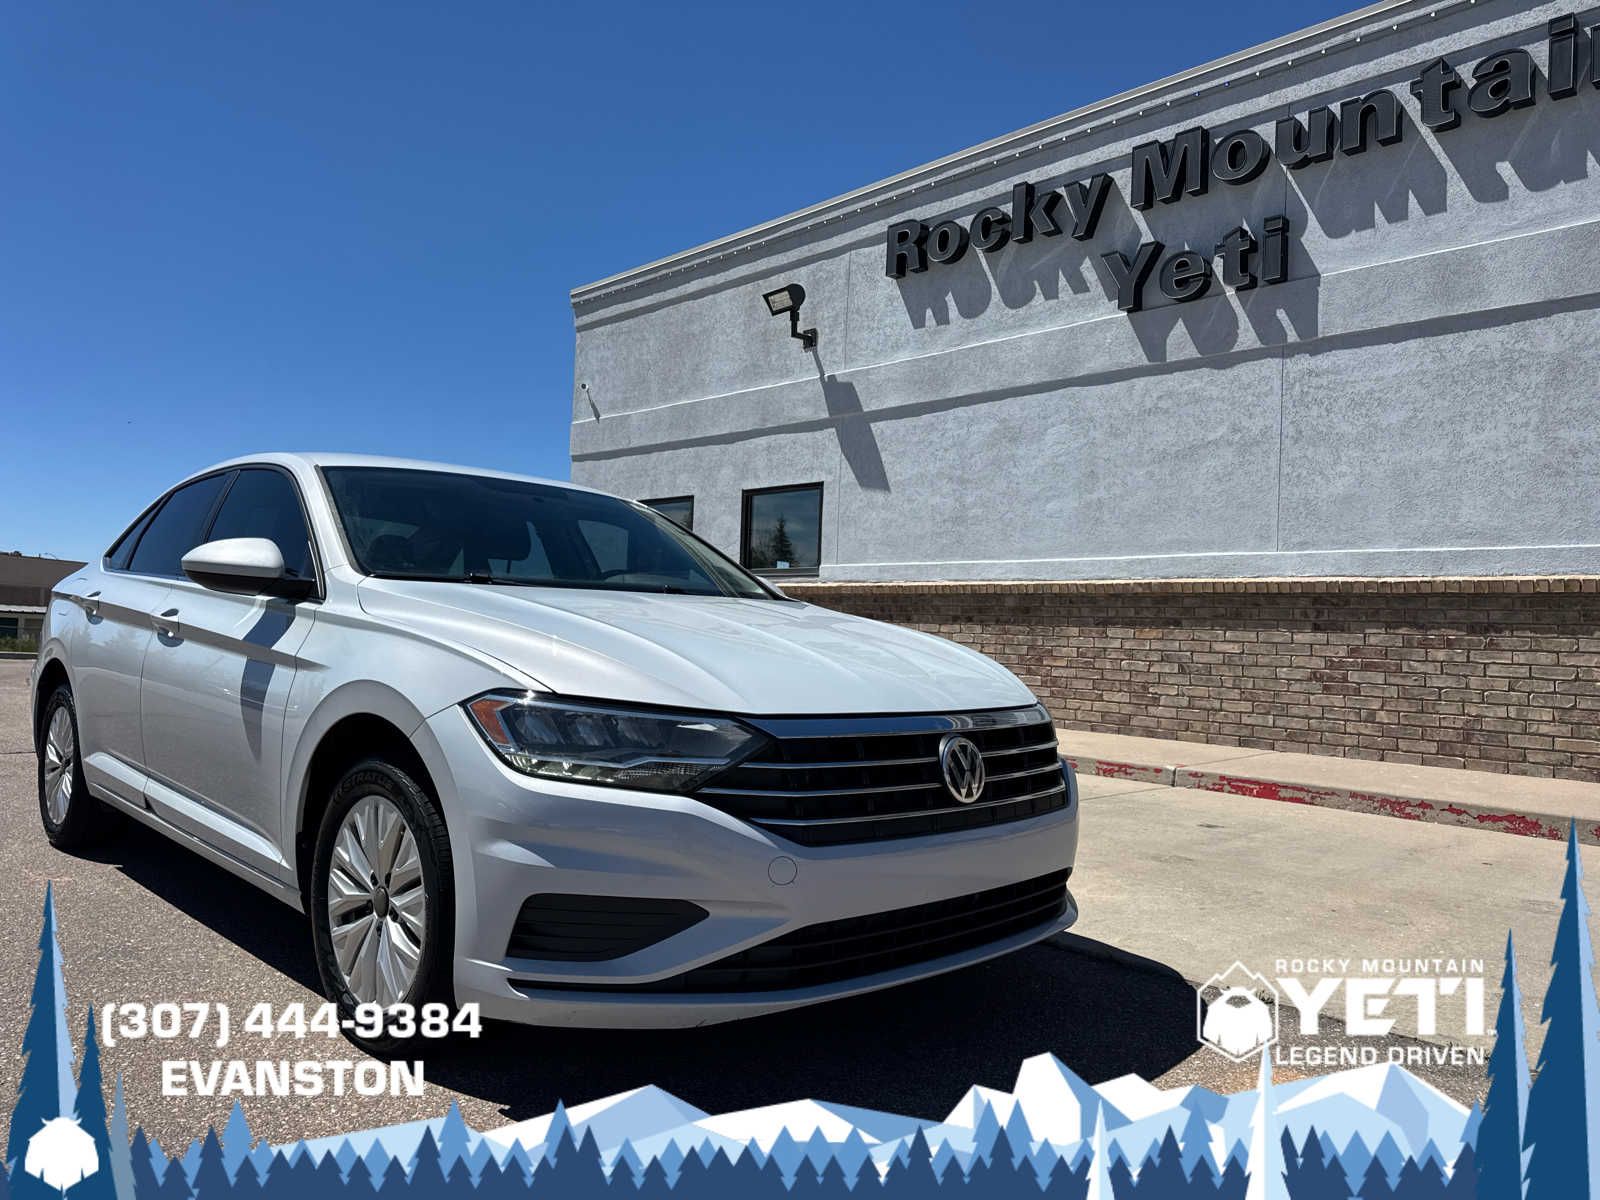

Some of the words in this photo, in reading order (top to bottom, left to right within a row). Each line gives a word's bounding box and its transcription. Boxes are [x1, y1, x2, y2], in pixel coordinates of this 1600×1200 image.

[886, 173, 1112, 279] Rocky
[1130, 12, 1600, 210] Mountai
[1101, 215, 1289, 312] Yeti
